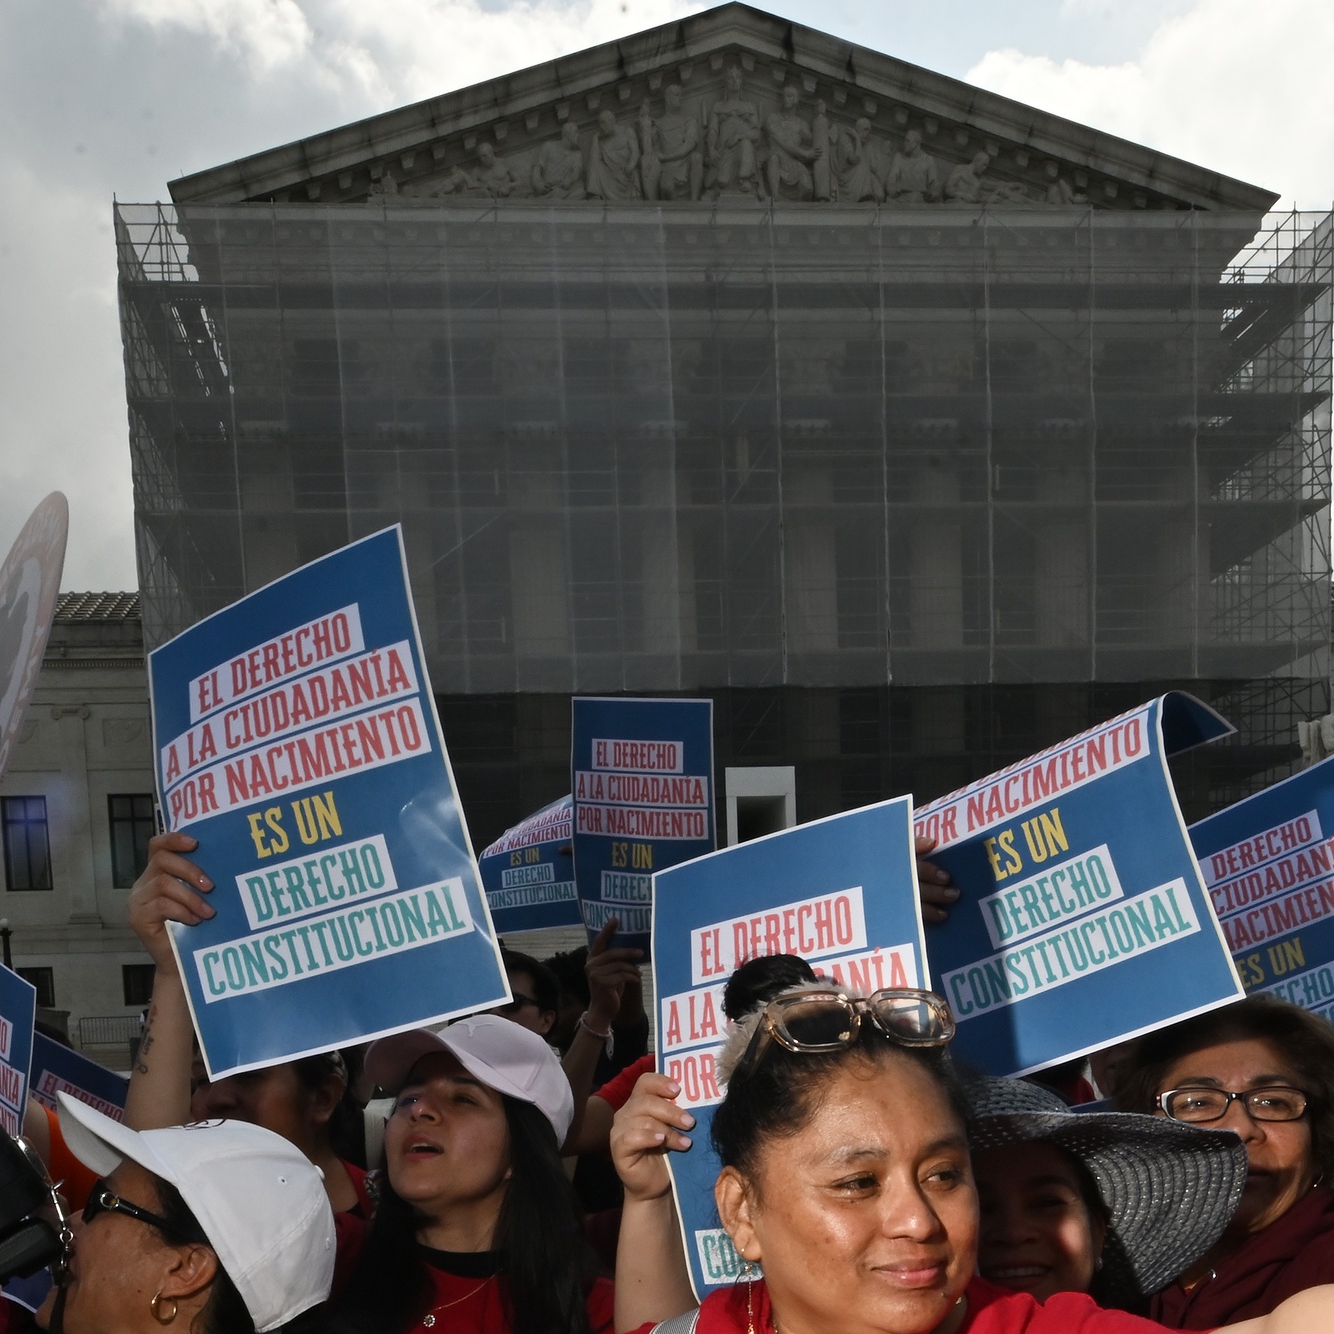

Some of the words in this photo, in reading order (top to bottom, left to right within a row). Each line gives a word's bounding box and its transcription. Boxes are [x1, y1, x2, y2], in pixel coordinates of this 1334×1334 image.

[198, 673, 223, 714] EL
[231, 612, 352, 701] DERECHO
[166, 744, 182, 784] A
[187, 720, 218, 767] LA
[224, 649, 411, 750] CIUDADANÍA
[171, 775, 219, 832] POR
[225, 705, 422, 804] NACIMIENTO
[596, 741, 610, 768] EL
[613, 743, 677, 770] DERECHO
[967, 718, 1141, 833] NACIMIENTO
[577, 773, 586, 798] A
[590, 775, 604, 800] LA
[608, 775, 705, 804] CIUDADANÍA
[248, 809, 288, 859] ES
[292, 791, 343, 846] UN
[486, 842, 505, 856] POR
[508, 823, 570, 850] NACIMIENTO
[578, 807, 603, 833] POR
[606, 809, 704, 838] NACIMIENTO
[984, 828, 1015, 881] ES
[1021, 808, 1069, 863] UN
[1211, 817, 1312, 881] DERECHO
[245, 844, 386, 922] DERECHO
[505, 865, 551, 885] DERECHO
[510, 852, 522, 866] ES
[526, 847, 539, 862] UN
[612, 843, 628, 867] ES
[632, 844, 653, 869] UN
[487, 883, 575, 908] CONSTITUCIONAL
[605, 874, 652, 901] DEREC
[987, 855, 1112, 941] DERECHO
[202, 885, 466, 996] CONSTITUCIONAL
[700, 928, 726, 978] EL
[733, 895, 853, 970] DERECHO
[950, 889, 1192, 1016] CONSTITUCIONAL
[1235, 953, 1265, 989] ES
[1268, 937, 1306, 976] UN
[667, 1006, 682, 1046] A
[689, 992, 718, 1040] LA
[43, 1074, 58, 1097] EL
[669, 1053, 720, 1103] POR
